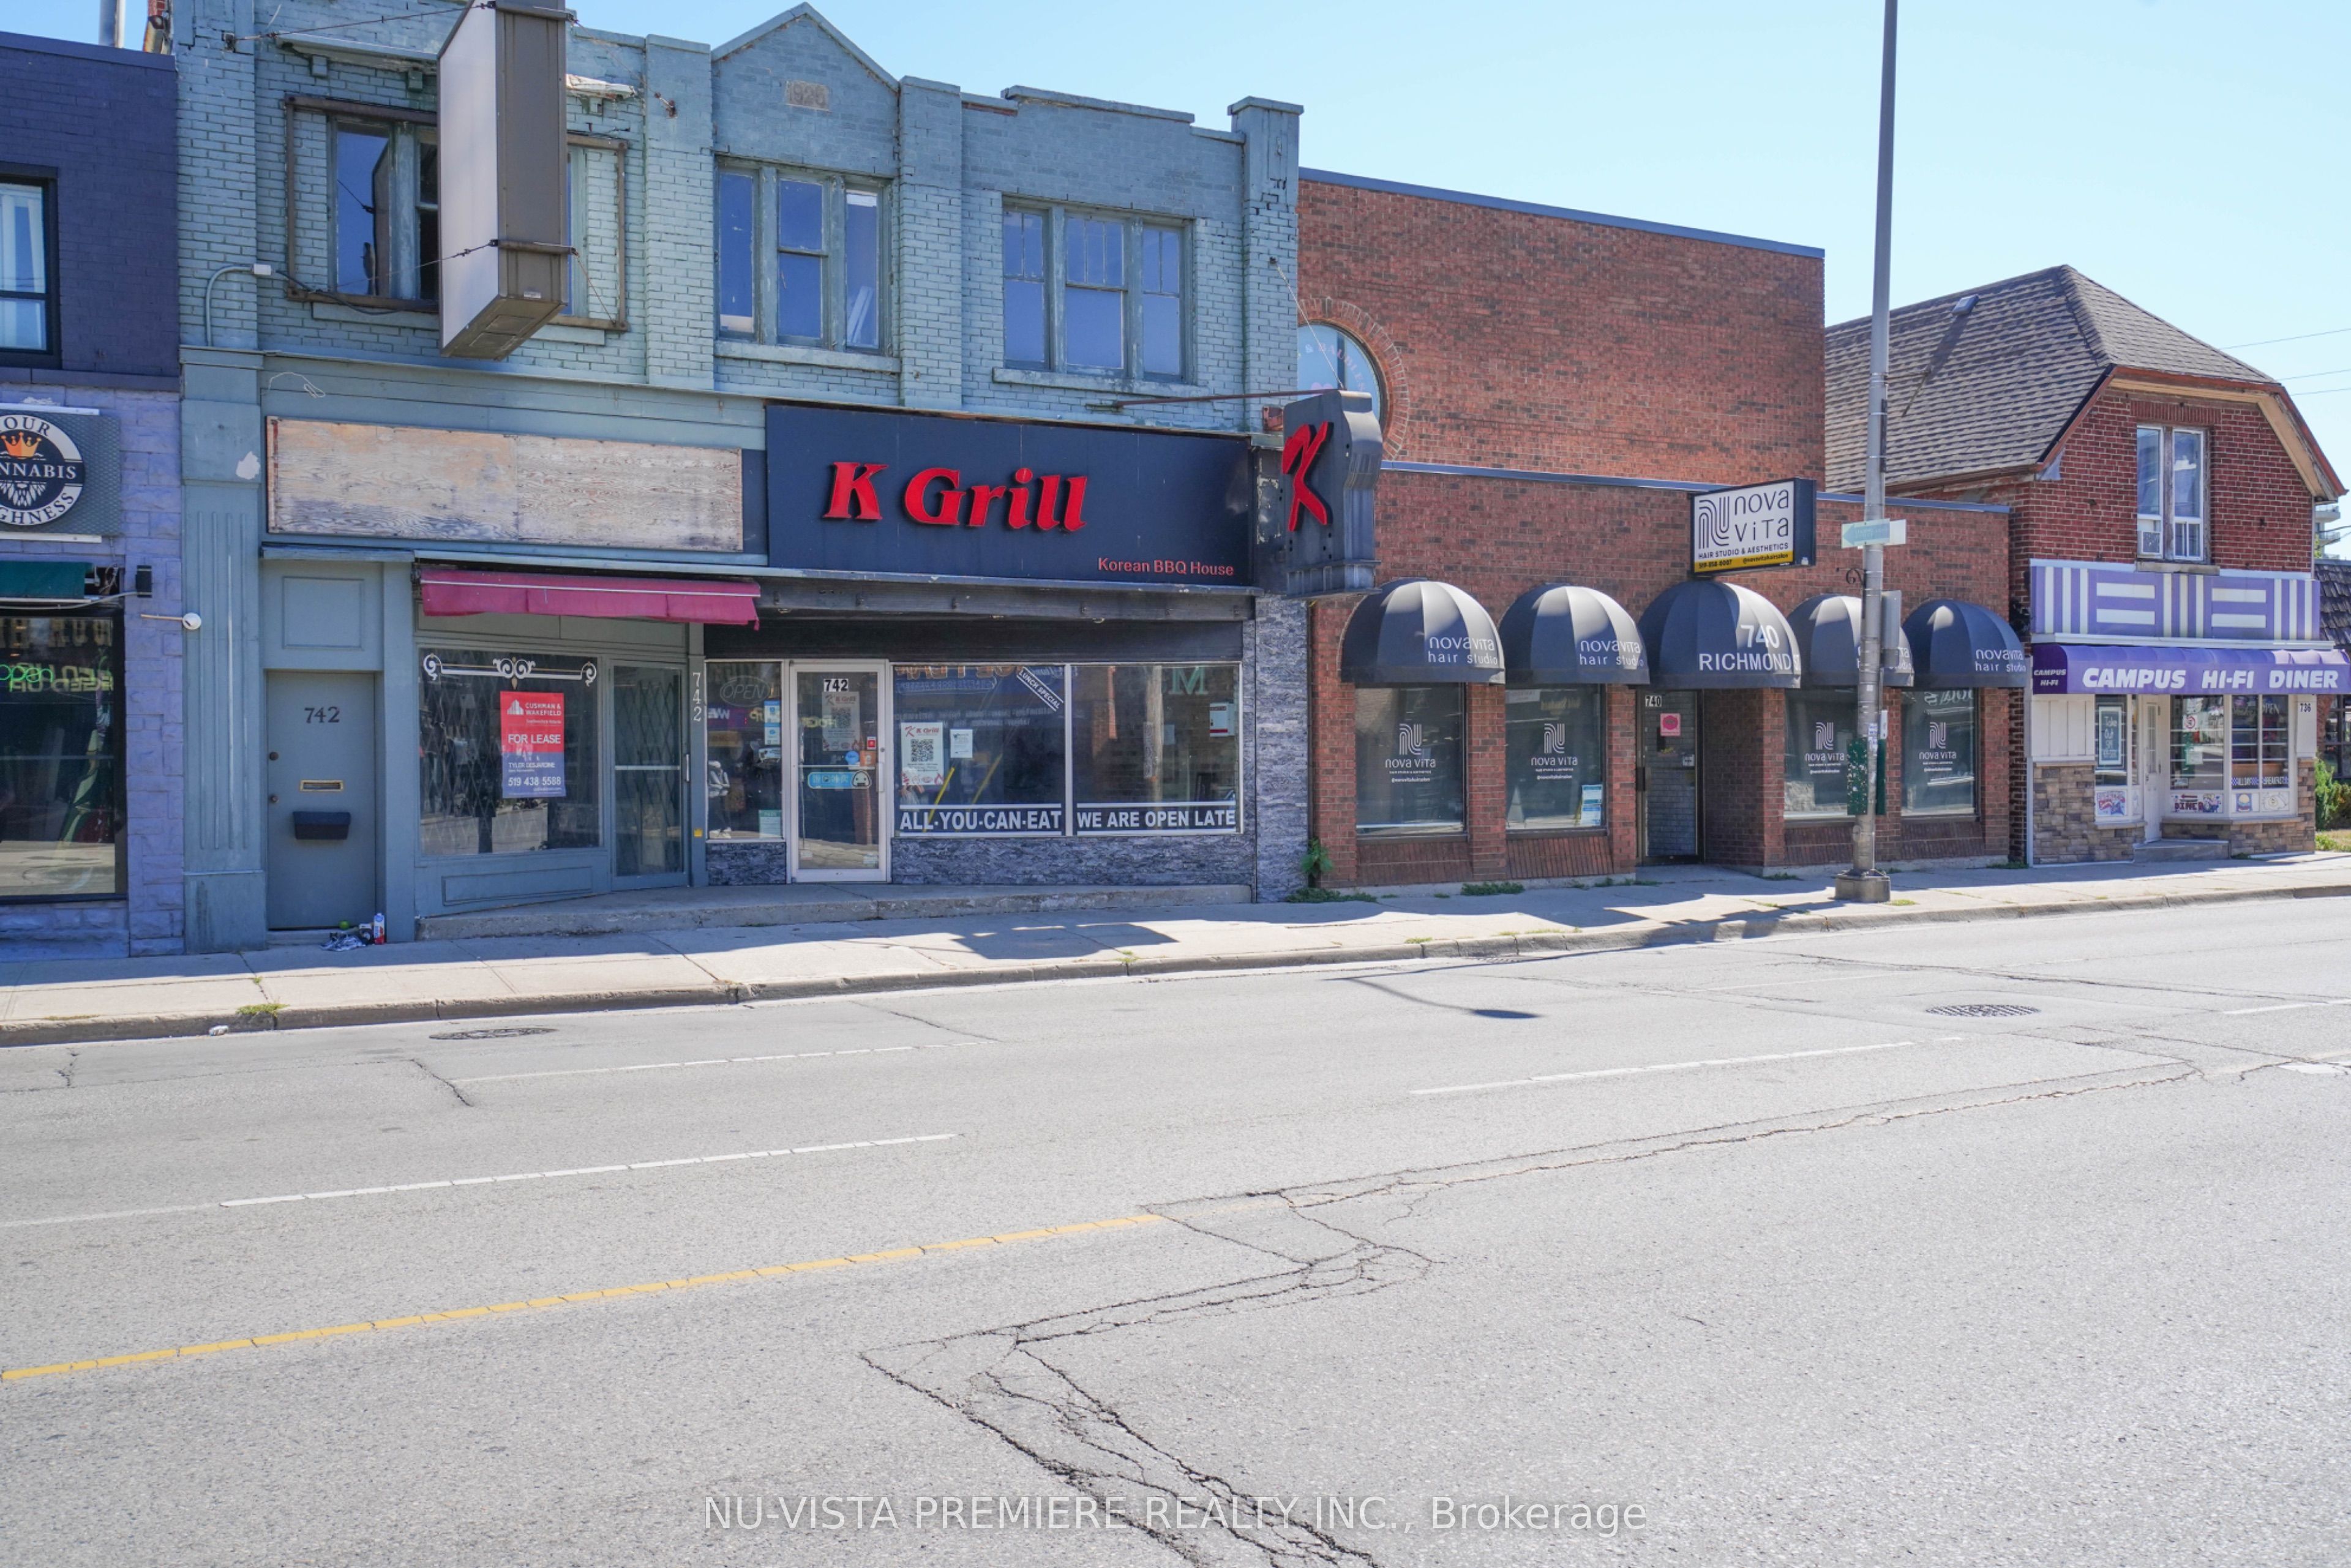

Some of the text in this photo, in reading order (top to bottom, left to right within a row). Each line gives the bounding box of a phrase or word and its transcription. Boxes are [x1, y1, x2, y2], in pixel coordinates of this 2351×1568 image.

[823, 461, 1088, 532] K Grill
[1734, 489, 1789, 516] nova
[1715, 549, 1739, 558] STUDIO
[1747, 542, 1789, 554] AESTHETICS
[1098, 557, 1234, 576] Korean BBQ House
[1741, 625, 1779, 649] 740
[1428, 650, 1498, 665] hair studio
[1580, 653, 1608, 666] hair
[1699, 653, 1791, 671] RICHMOND
[1975, 661, 1999, 672] hair
[825, 679, 848, 691] 742
[2083, 668, 2339, 689] CAMPUS HI-FI DINER
[722, 685, 765, 699] OPEN
[1019, 669, 1039, 689] LUNCH
[1037, 686, 1060, 709] SPECIAL
[1645, 696, 1661, 707] 740
[304, 706, 340, 723] 742
[508, 734, 561, 744] FOR LEASE
[1531, 757, 1556, 766] nova
[1919, 751, 1938, 760] nova
[1385, 759, 1412, 768] nova
[508, 776, 561, 787] 519 438 5588
[1077, 809, 1236, 828] WE ARE OPEN LATE
